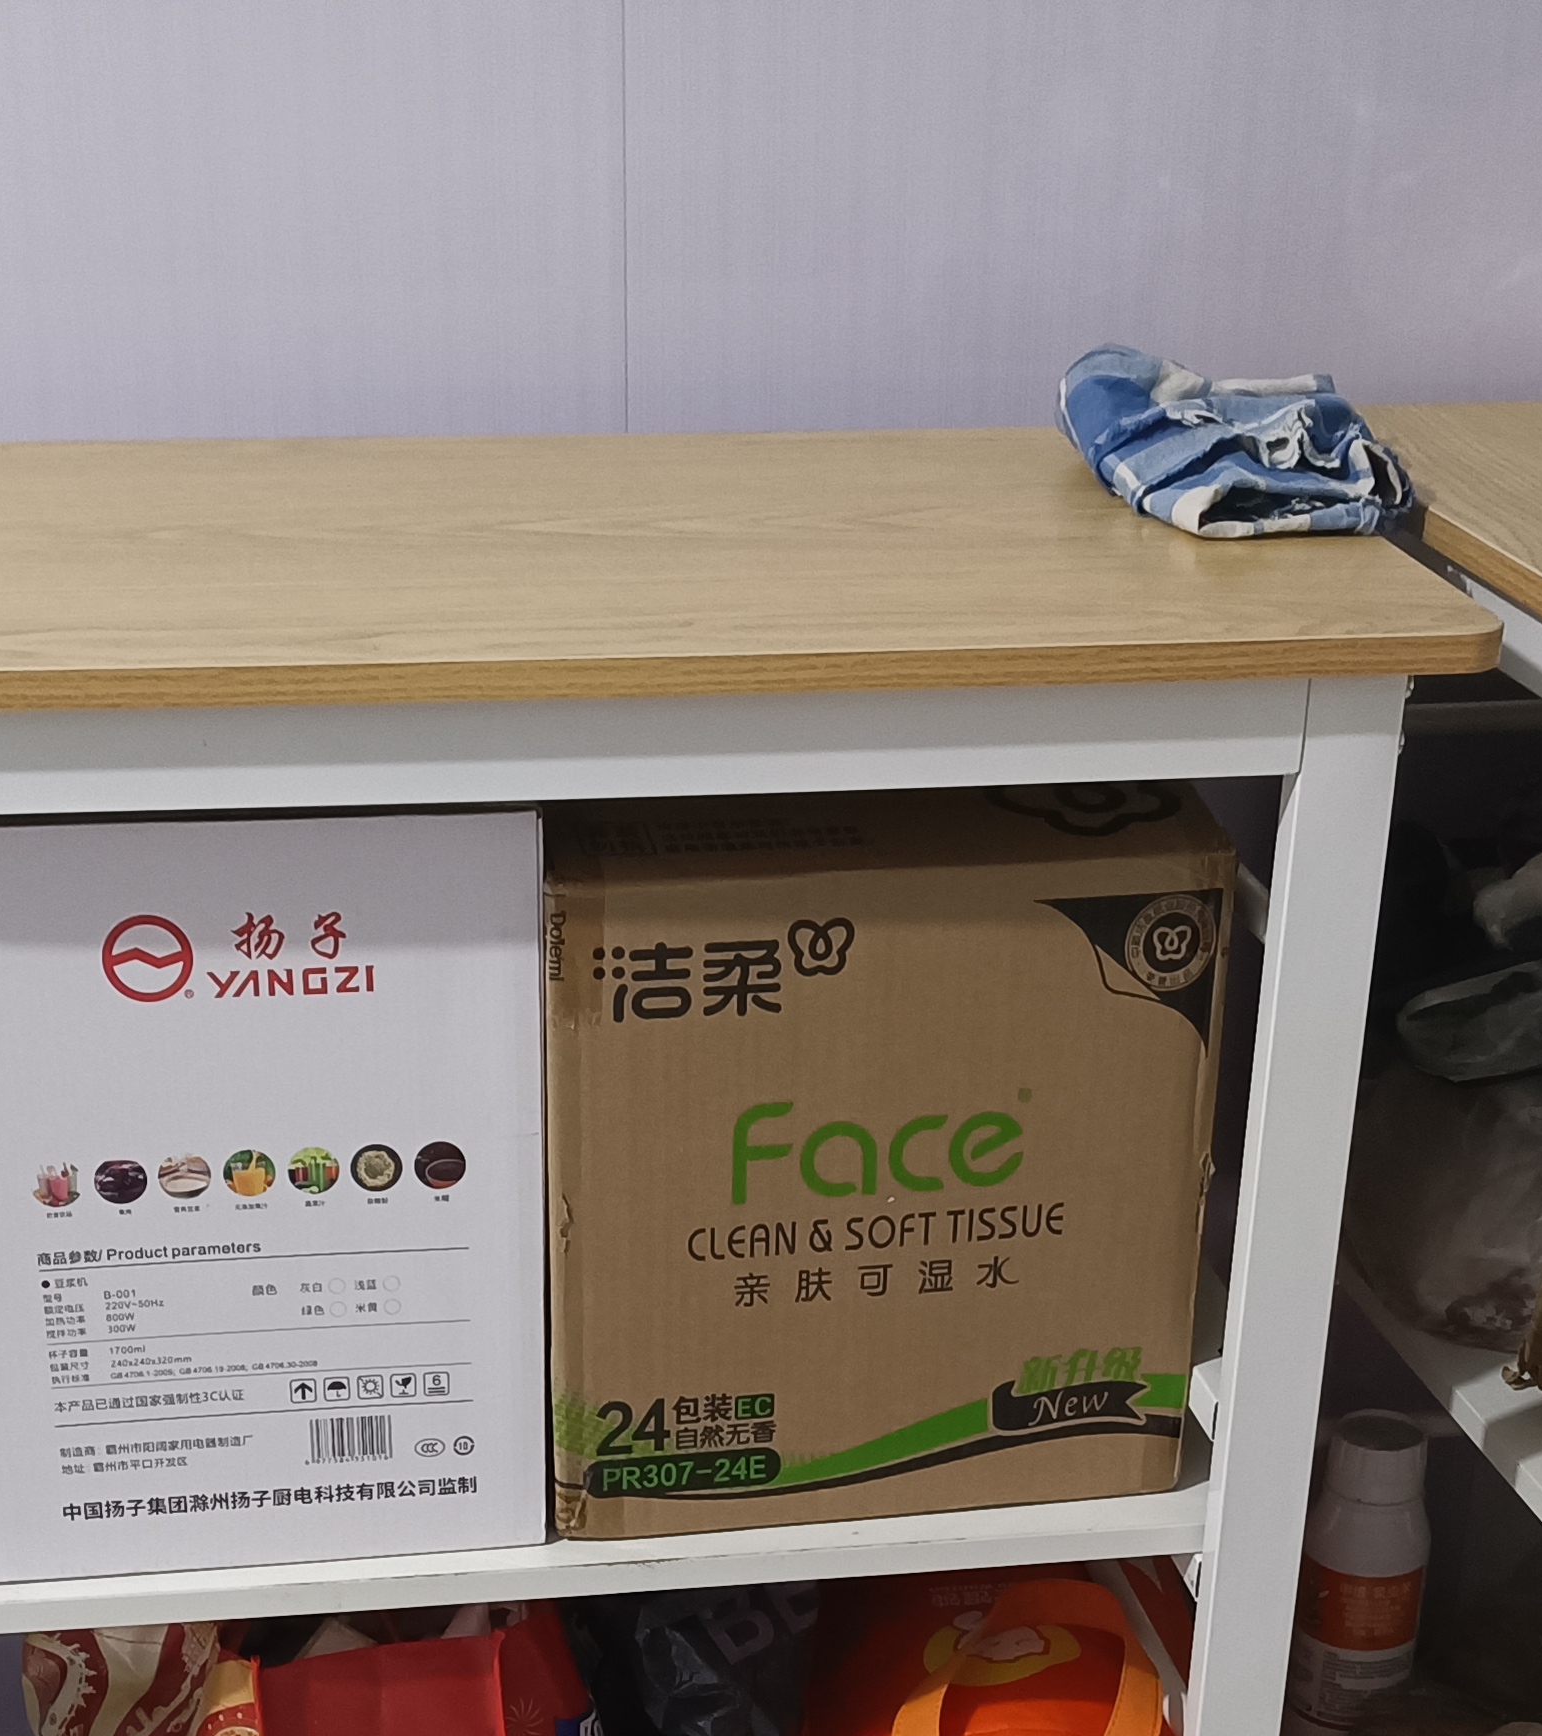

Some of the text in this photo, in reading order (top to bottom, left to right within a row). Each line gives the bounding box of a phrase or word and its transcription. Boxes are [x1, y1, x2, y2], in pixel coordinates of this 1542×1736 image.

[232, 911, 348, 960] 扬子
[206, 964, 376, 999] YANGZI
[592, 938, 783, 1024] 洁柔
[730, 1101, 1025, 1206] Face
[687, 1200, 1066, 1263] CLEAN & SOFT TISSUE
[106, 1246, 169, 1261] Product
[171, 1241, 262, 1260] parameters
[54, 1277, 89, 1289] 豆浆机
[103, 1289, 137, 1300] B-001
[251, 1283, 278, 1297] 颜色
[299, 1281, 323, 1294] 灰白
[733, 1255, 1020, 1308] 亲肤可湿水
[107, 1323, 137, 1334] 300W
[109, 1345, 146, 1355] 1700ml
[595, 1393, 772, 1457] 24 包装 EC
[1027, 1389, 1109, 1427] New
[675, 1420, 777, 1451] 自然无香
[601, 1454, 767, 1492] PR307-24E
[62, 1475, 478, 1522] 中国扬子集团滁州扬子厨电科技有限公司监制
